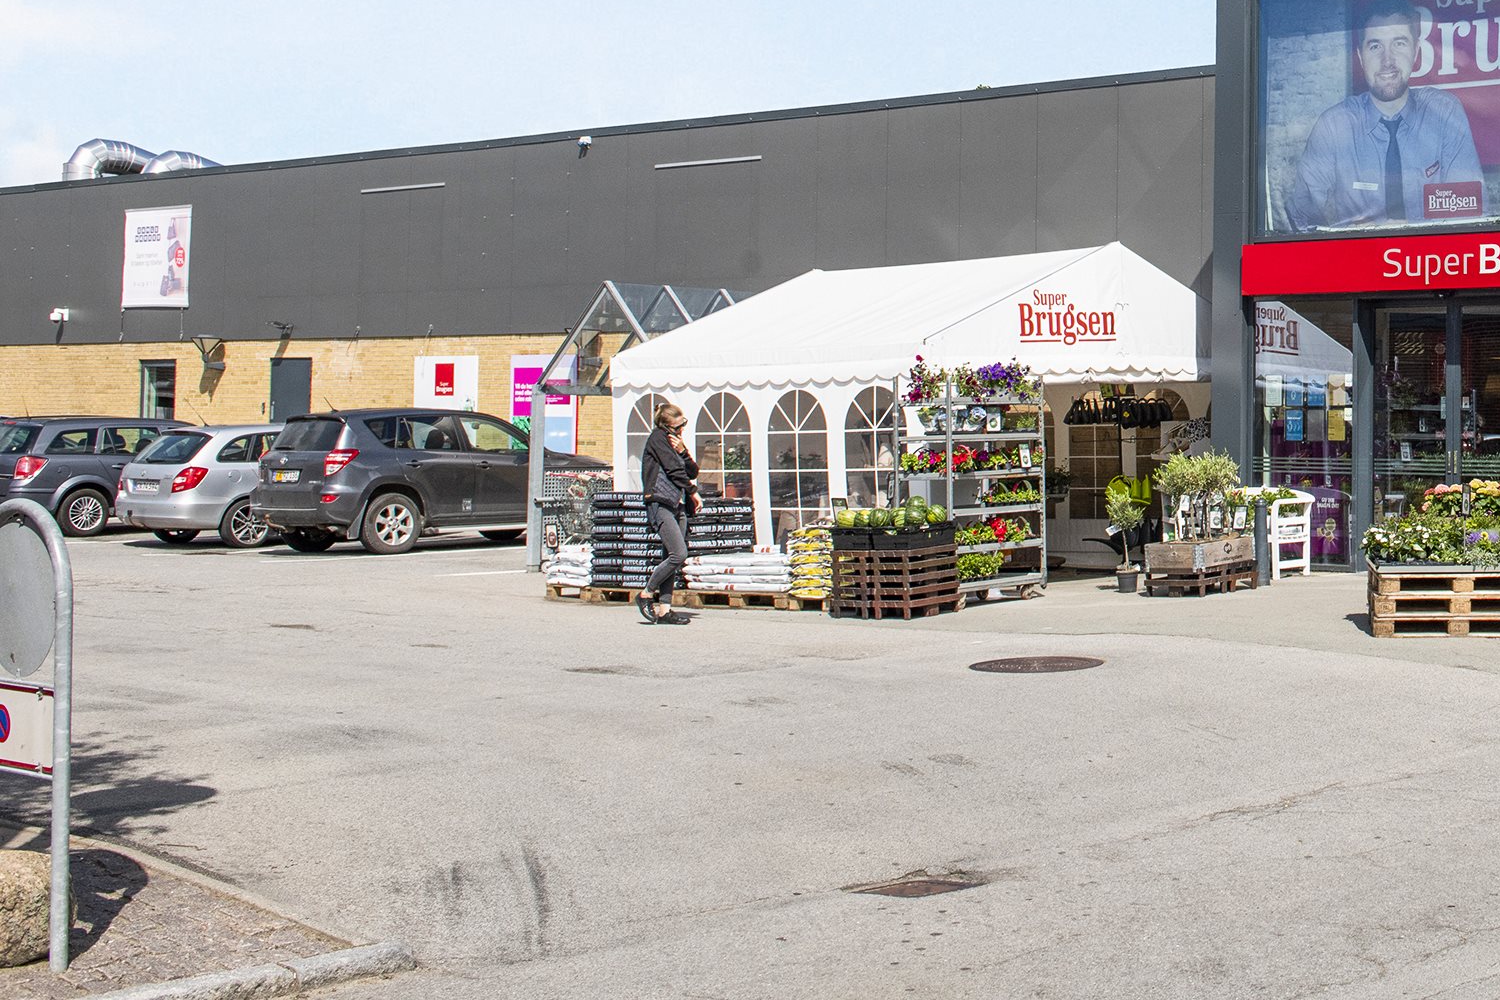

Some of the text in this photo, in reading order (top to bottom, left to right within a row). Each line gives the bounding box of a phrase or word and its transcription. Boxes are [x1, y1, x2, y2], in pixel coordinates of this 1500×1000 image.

[1428, 194, 1477, 212] Brugsen
[1435, 189, 1453, 198] Super
[1033, 289, 1067, 310] Super
[1018, 303, 1116, 345] Brugsen
